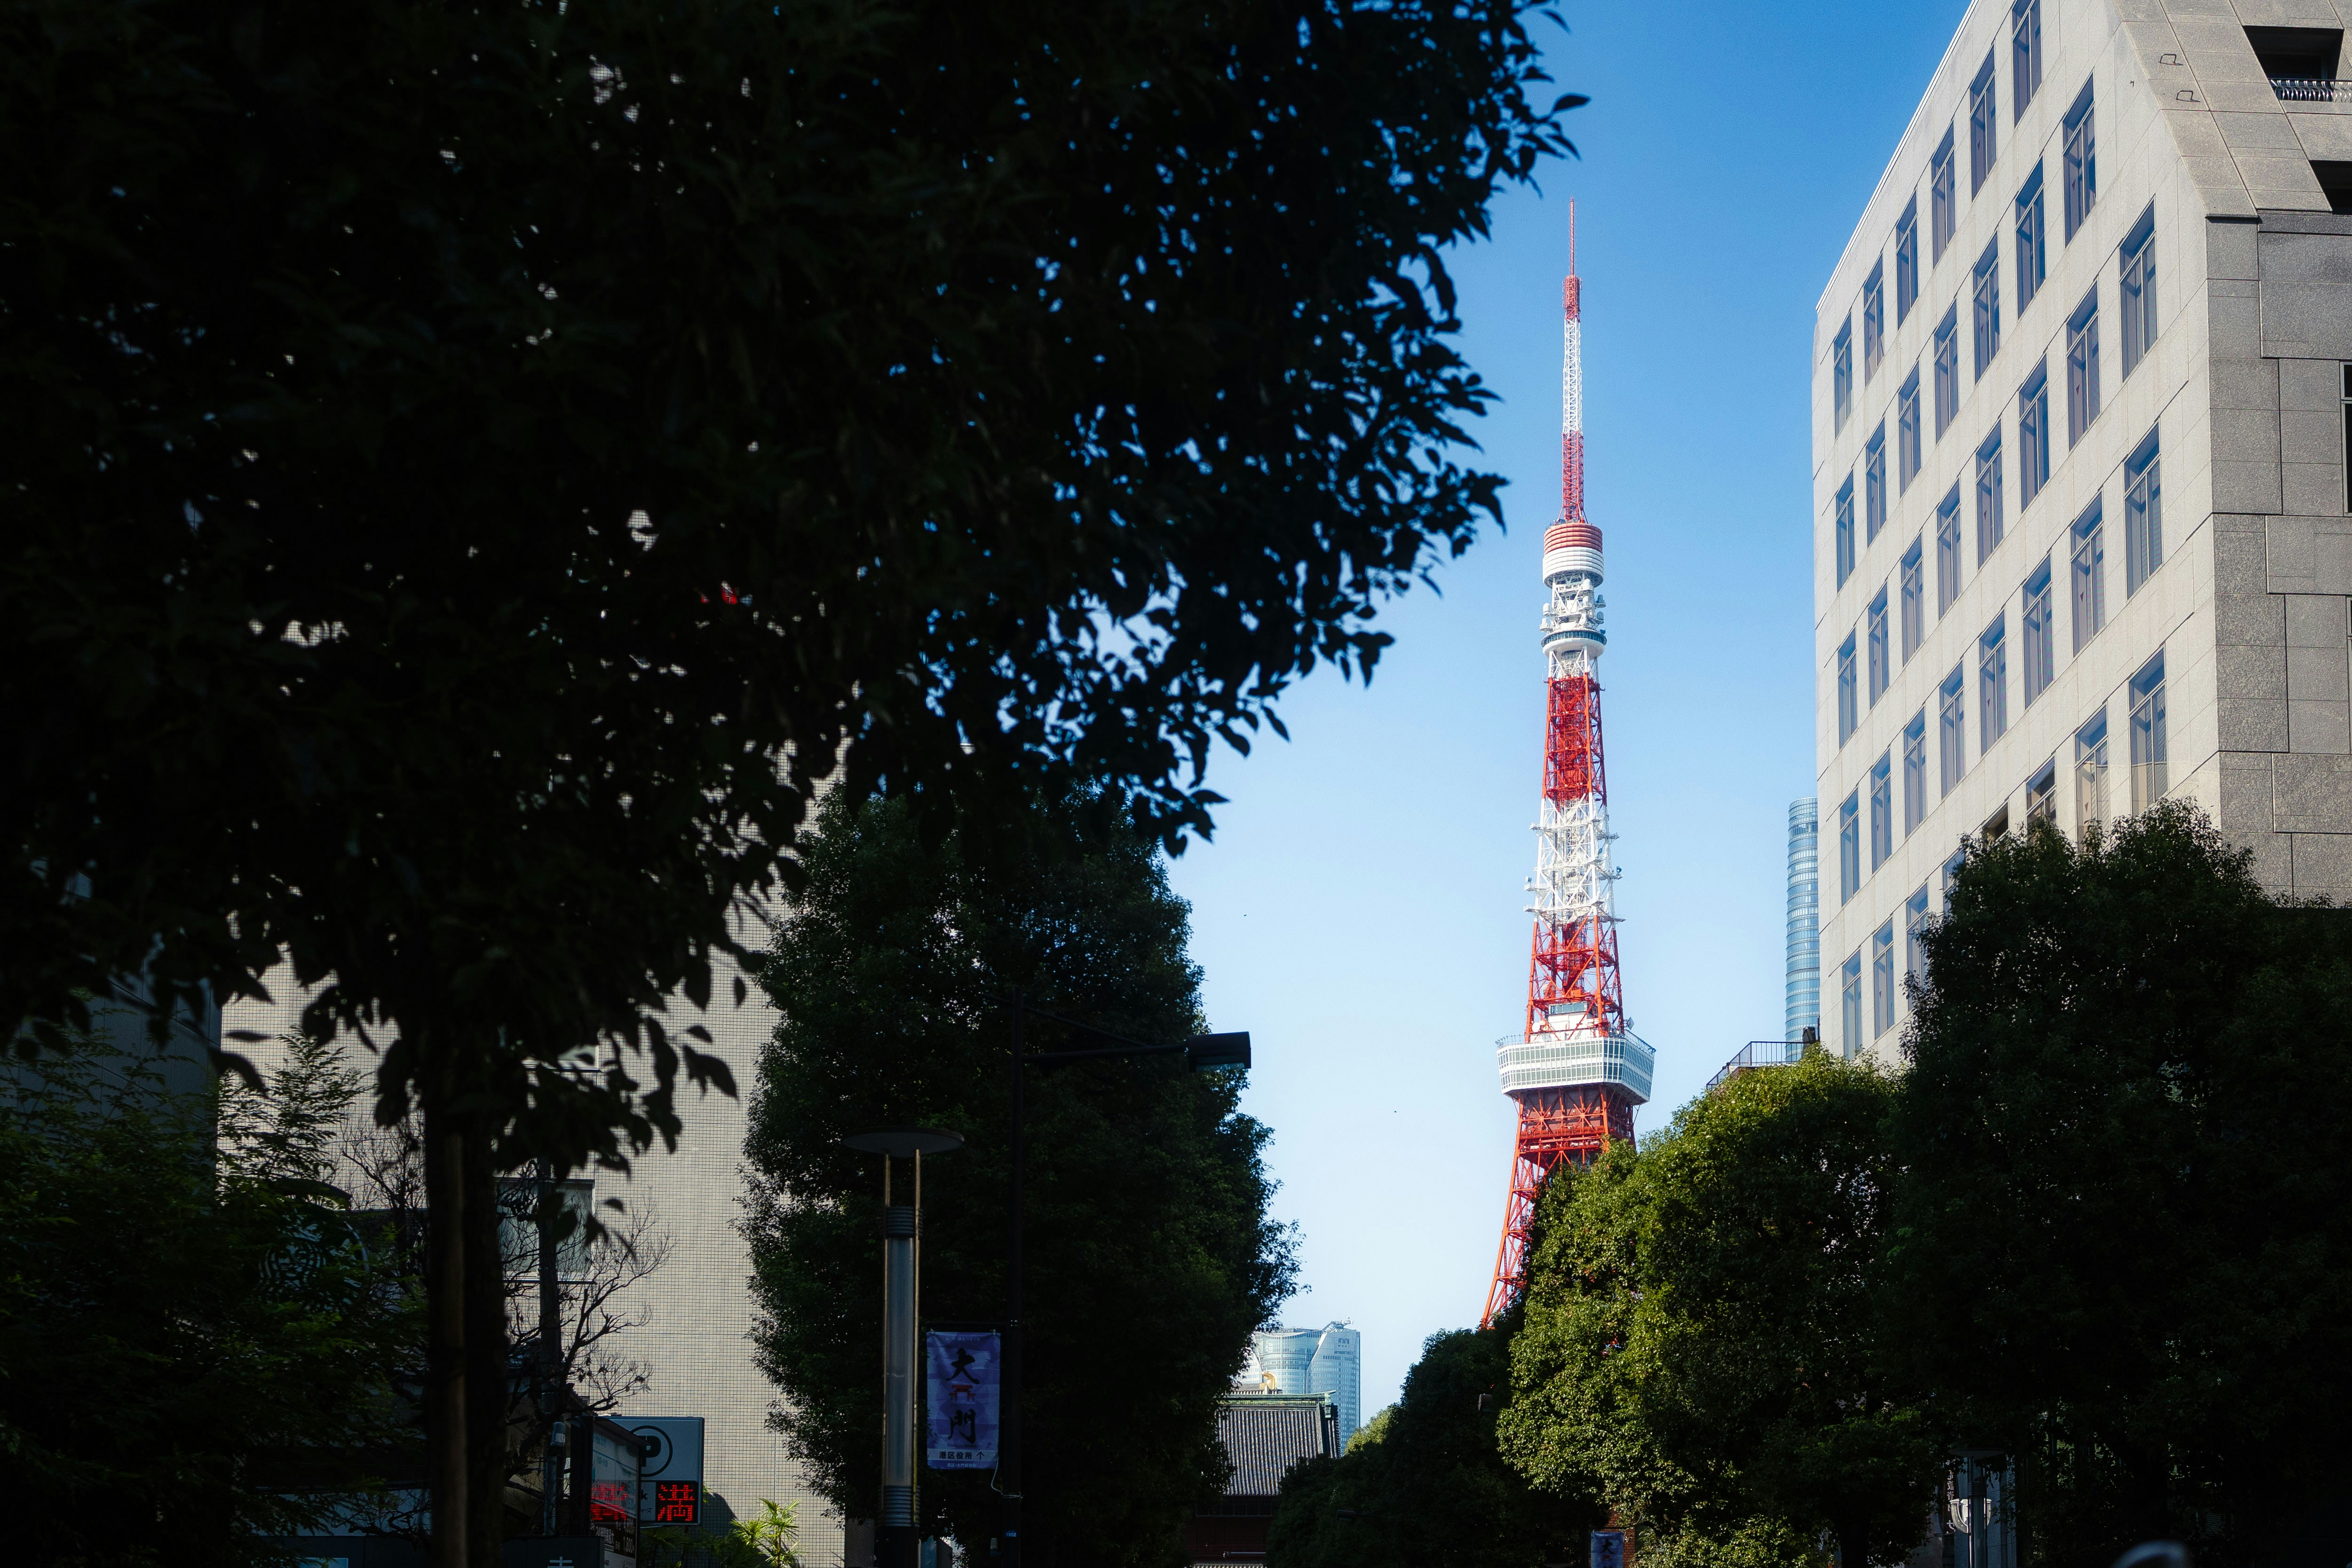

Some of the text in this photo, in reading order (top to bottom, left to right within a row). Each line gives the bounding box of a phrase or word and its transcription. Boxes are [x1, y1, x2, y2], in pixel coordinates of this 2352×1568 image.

[939, 1451, 973, 1460] 港区役所
[657, 1484, 697, 1521] 満
